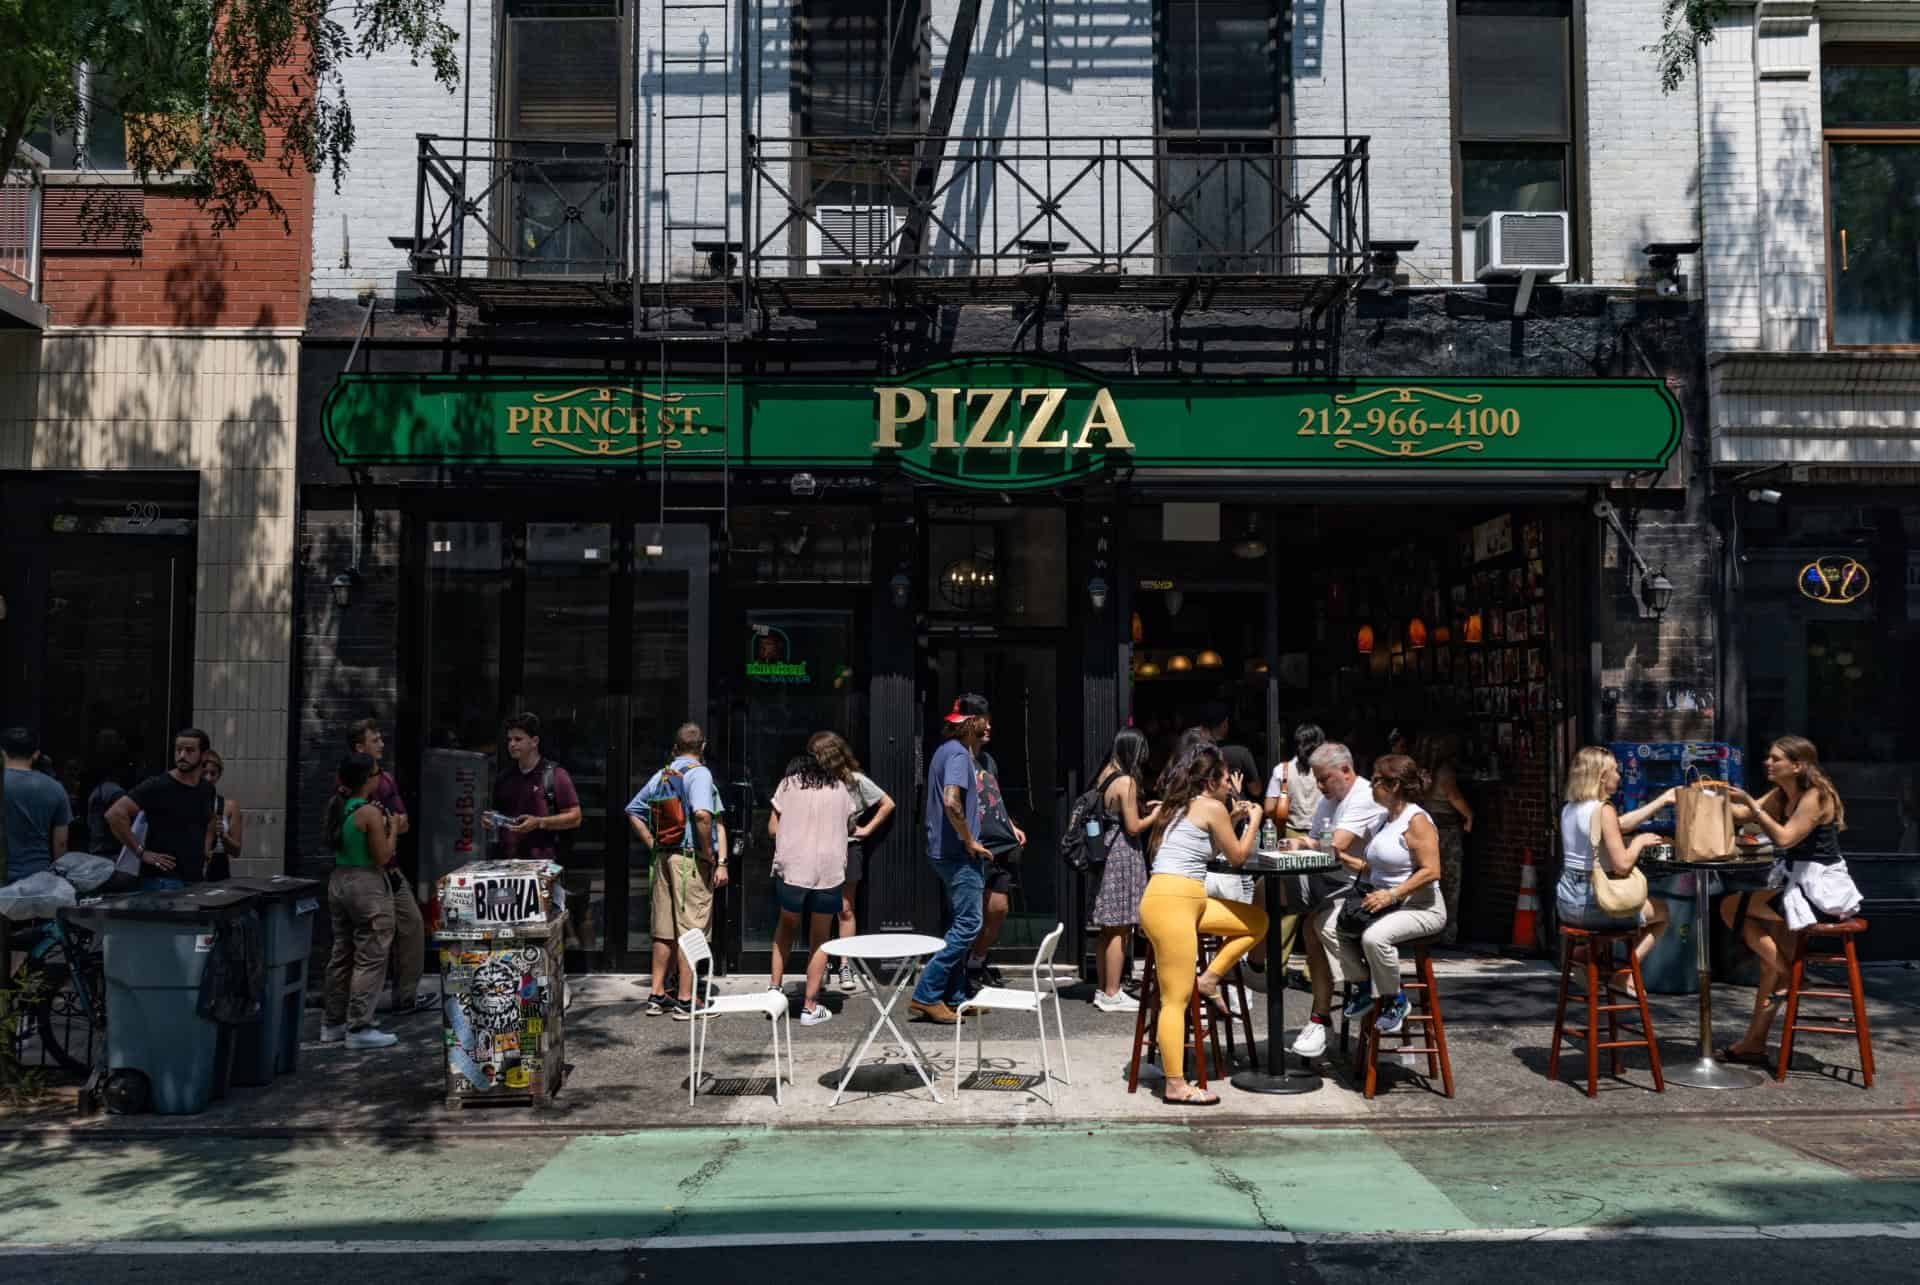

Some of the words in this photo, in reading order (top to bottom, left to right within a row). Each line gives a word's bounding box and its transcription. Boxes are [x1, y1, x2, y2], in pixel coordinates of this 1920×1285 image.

[506, 406, 648, 435] PRINCE
[657, 406, 709, 435] ST.
[871, 387, 1136, 449] PIZZA
[1296, 407, 1521, 436] 212-966-4100
[126, 501, 161, 526] 29
[1279, 855, 1333, 870] DELIVERING
[474, 878, 540, 921] BRUHA
